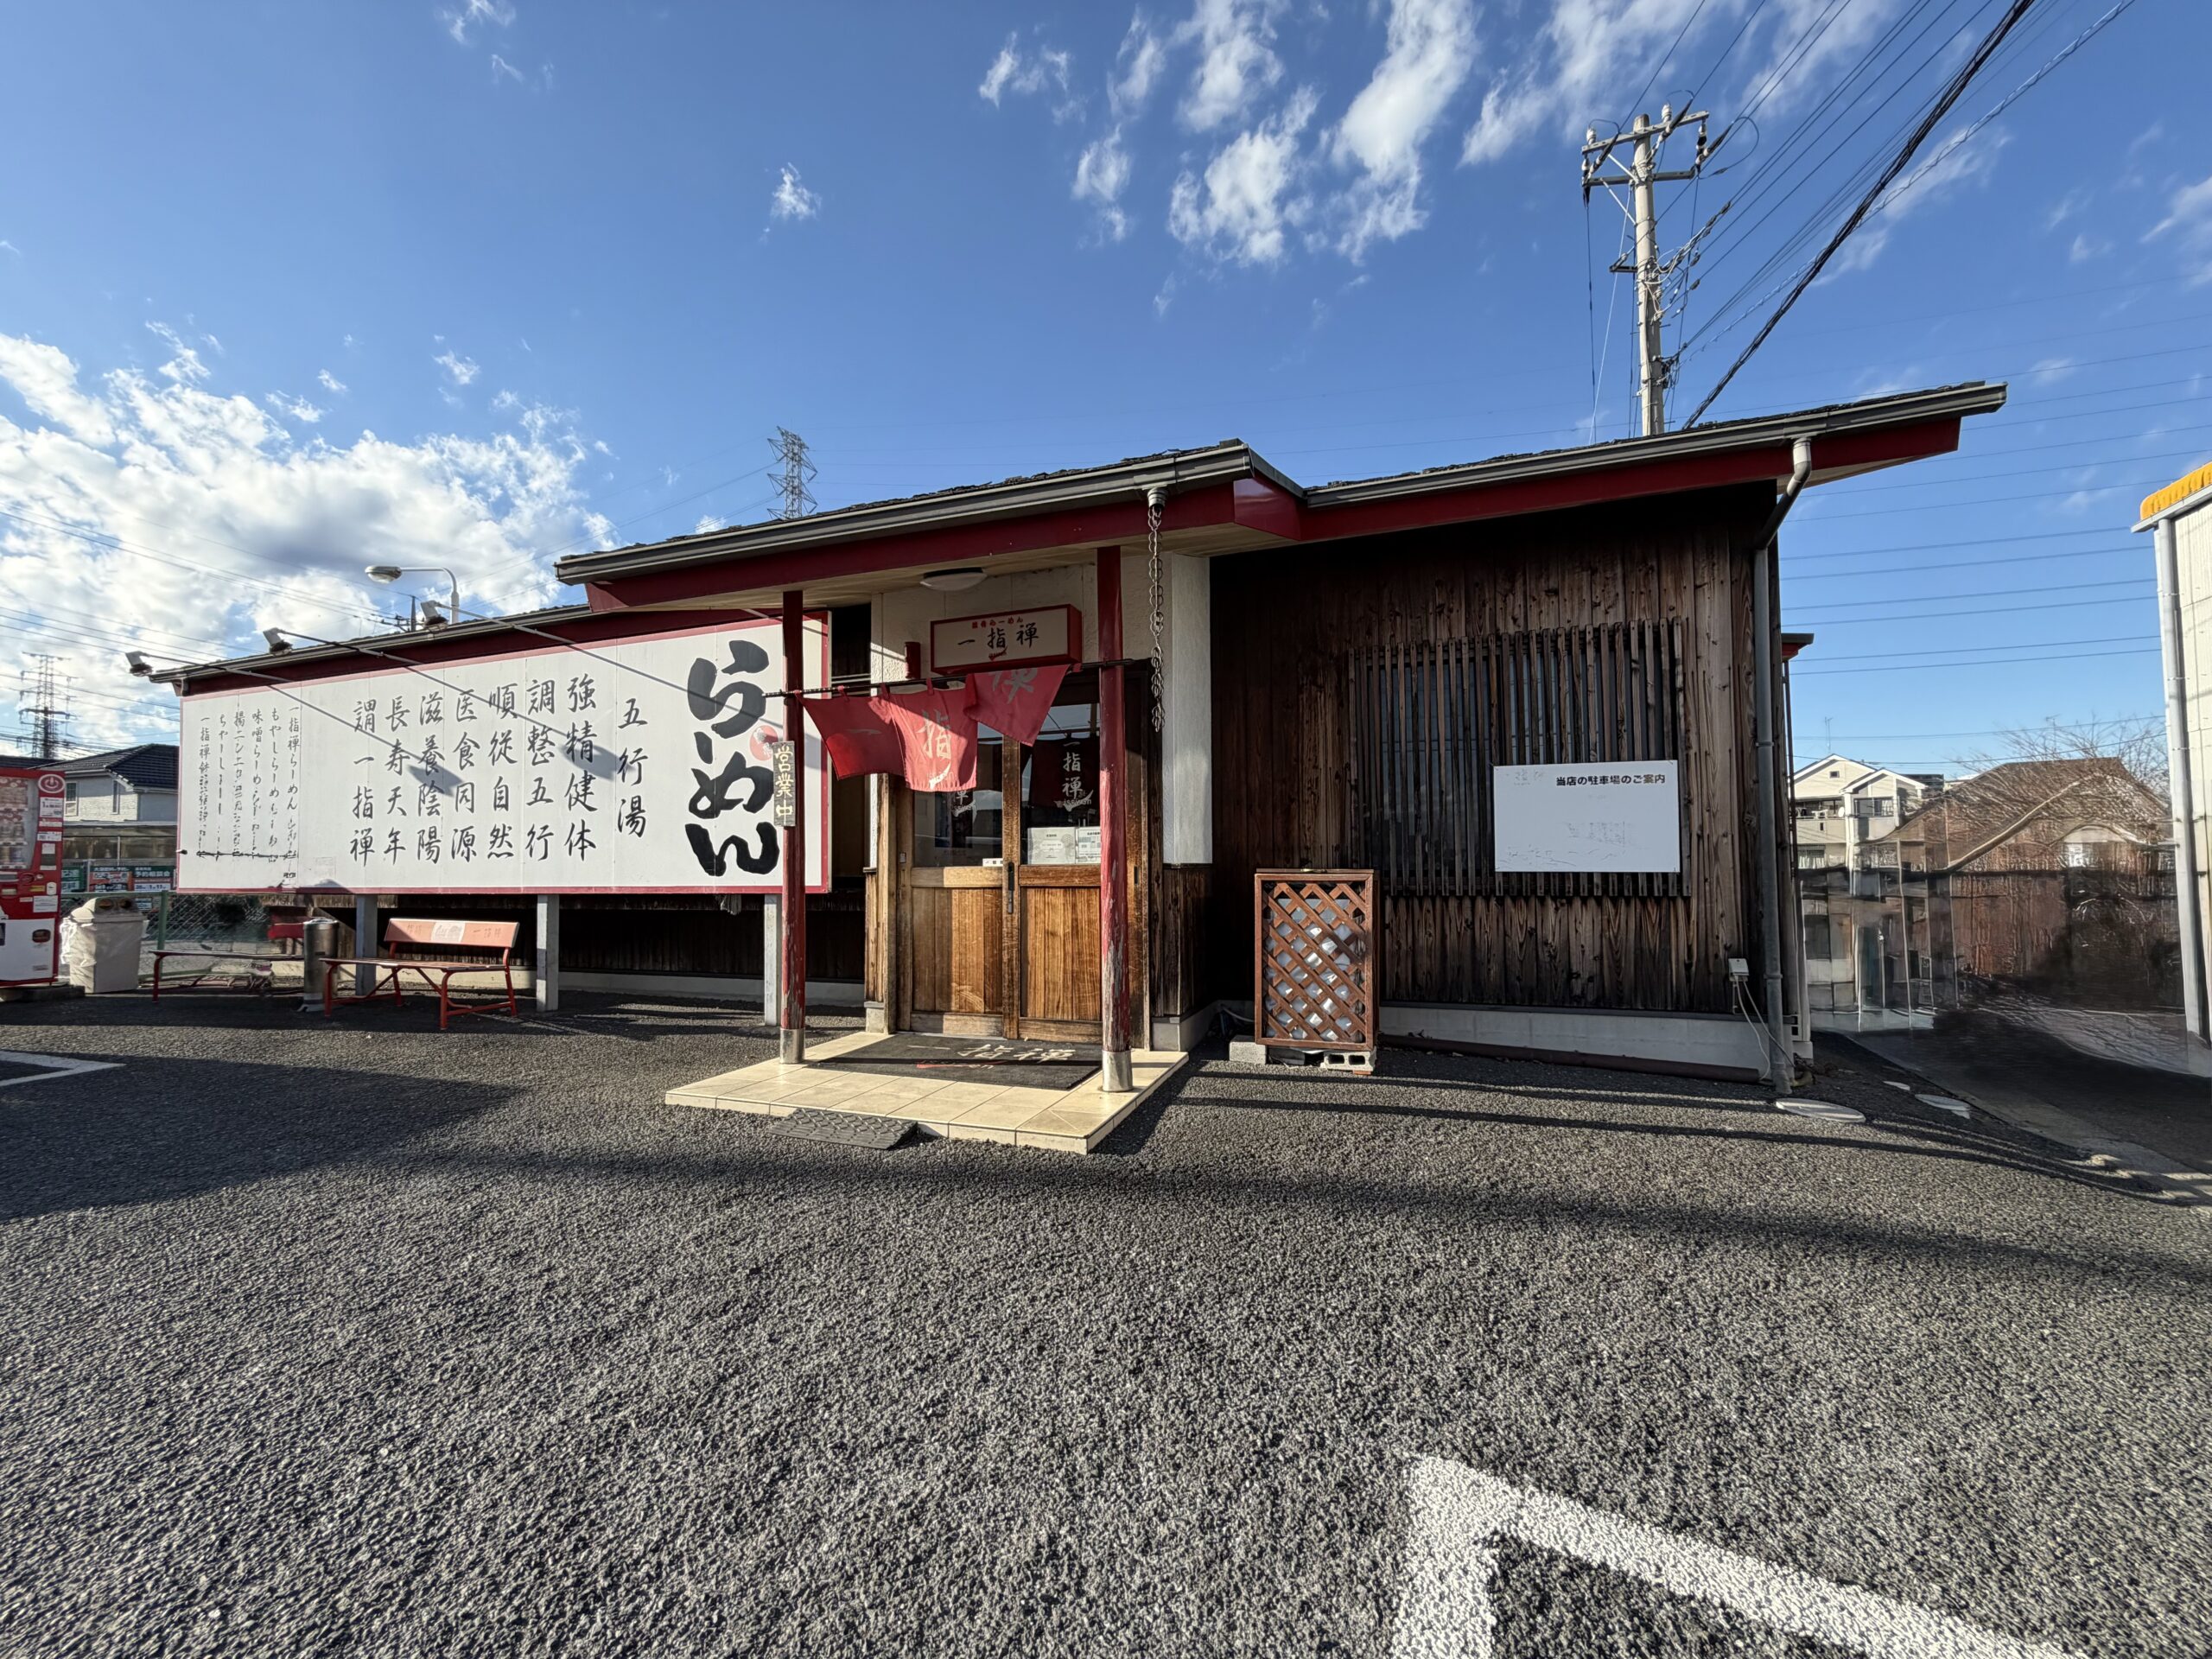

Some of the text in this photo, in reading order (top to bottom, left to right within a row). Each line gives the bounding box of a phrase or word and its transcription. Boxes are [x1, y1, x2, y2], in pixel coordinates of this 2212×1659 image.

[957, 622, 1039, 649] 一指禅
[350, 699, 377, 867] 謂一指禅
[384, 696, 410, 866] 長寿天年
[416, 691, 445, 864] 滋養陰陽
[451, 689, 480, 862] 医食同源
[525, 679, 556, 861] 調整五行
[564, 673, 598, 861] 強精健体
[617, 698, 648, 837] 五行湯
[774, 745, 794, 826] 営業中
[1062, 741, 1083, 799] 一指禅
[1556, 773, 1666, 786] 当店の駐車場のご案内
